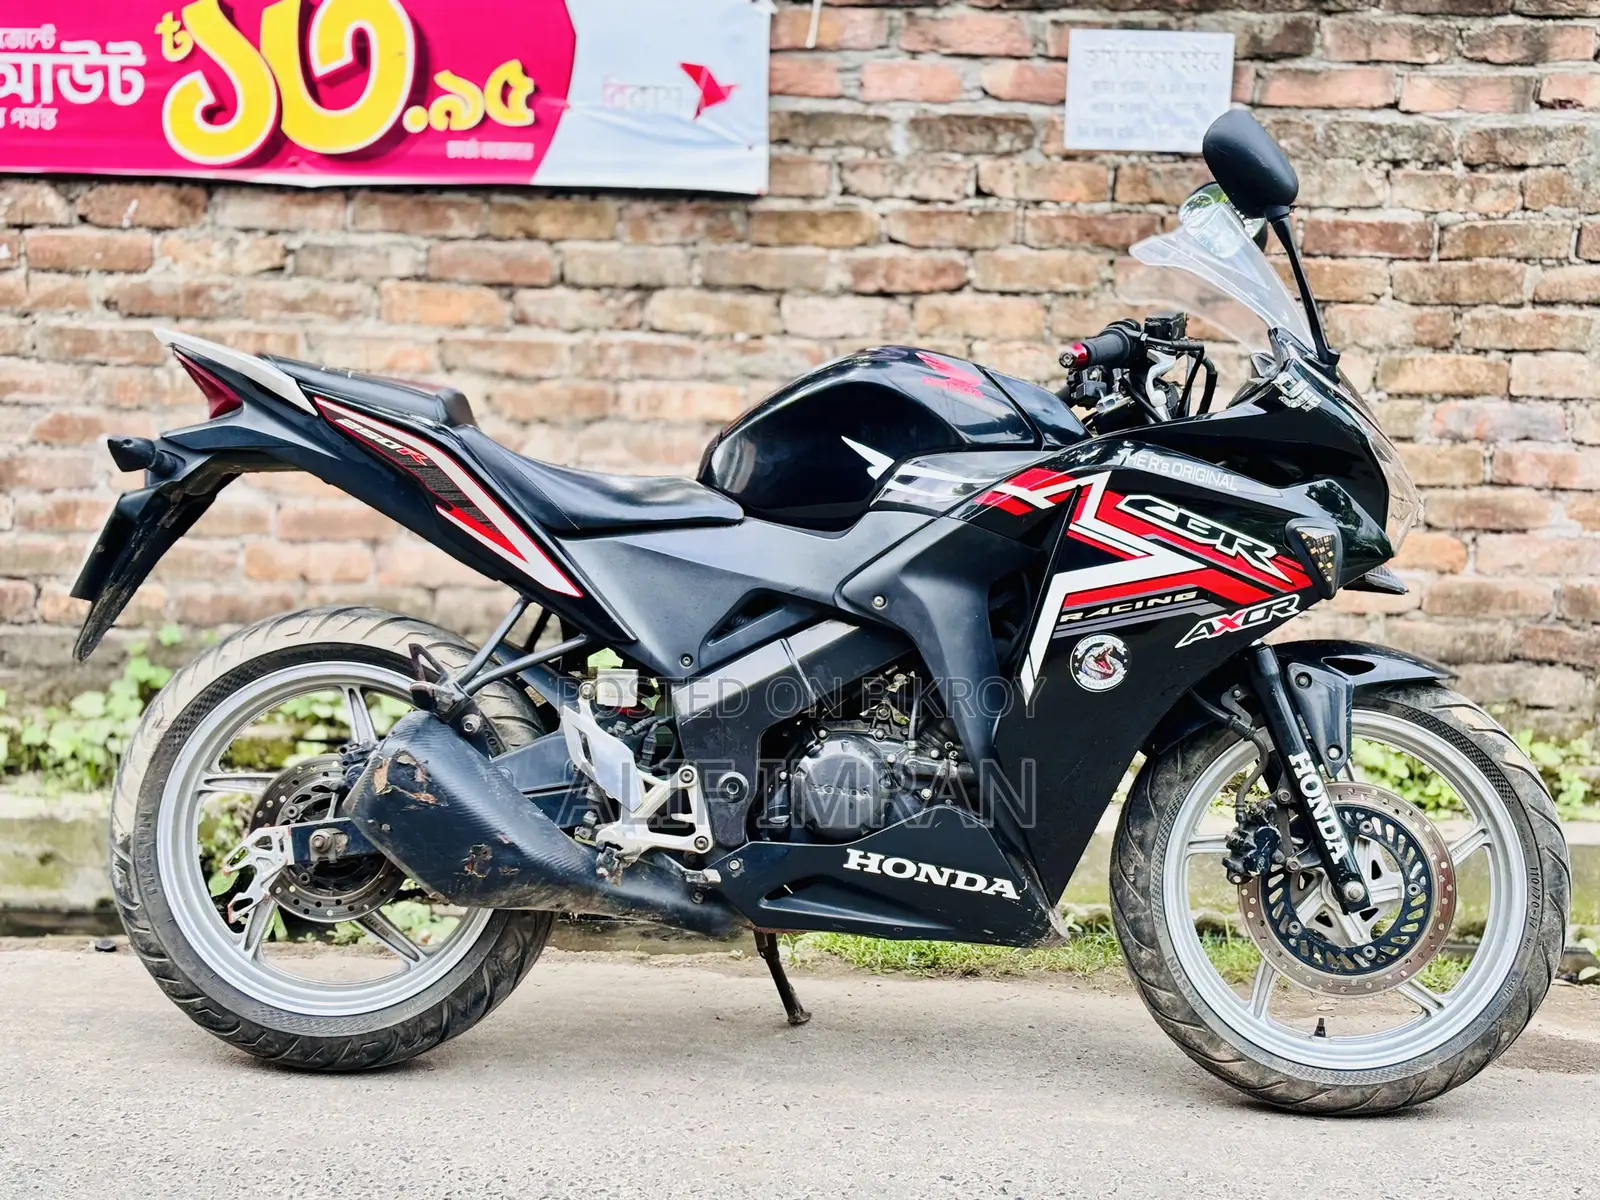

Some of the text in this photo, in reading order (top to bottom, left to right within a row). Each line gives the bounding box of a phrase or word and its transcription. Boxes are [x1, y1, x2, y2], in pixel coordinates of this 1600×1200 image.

[1170, 462, 1238, 491] ORIGINAL
[1115, 494, 1292, 583] CBR
[1060, 590, 1198, 623] RACING
[1288, 750, 1349, 865] HONDA
[843, 848, 1021, 900] HONDA
[1528, 865, 1541, 930] 110/70-17
